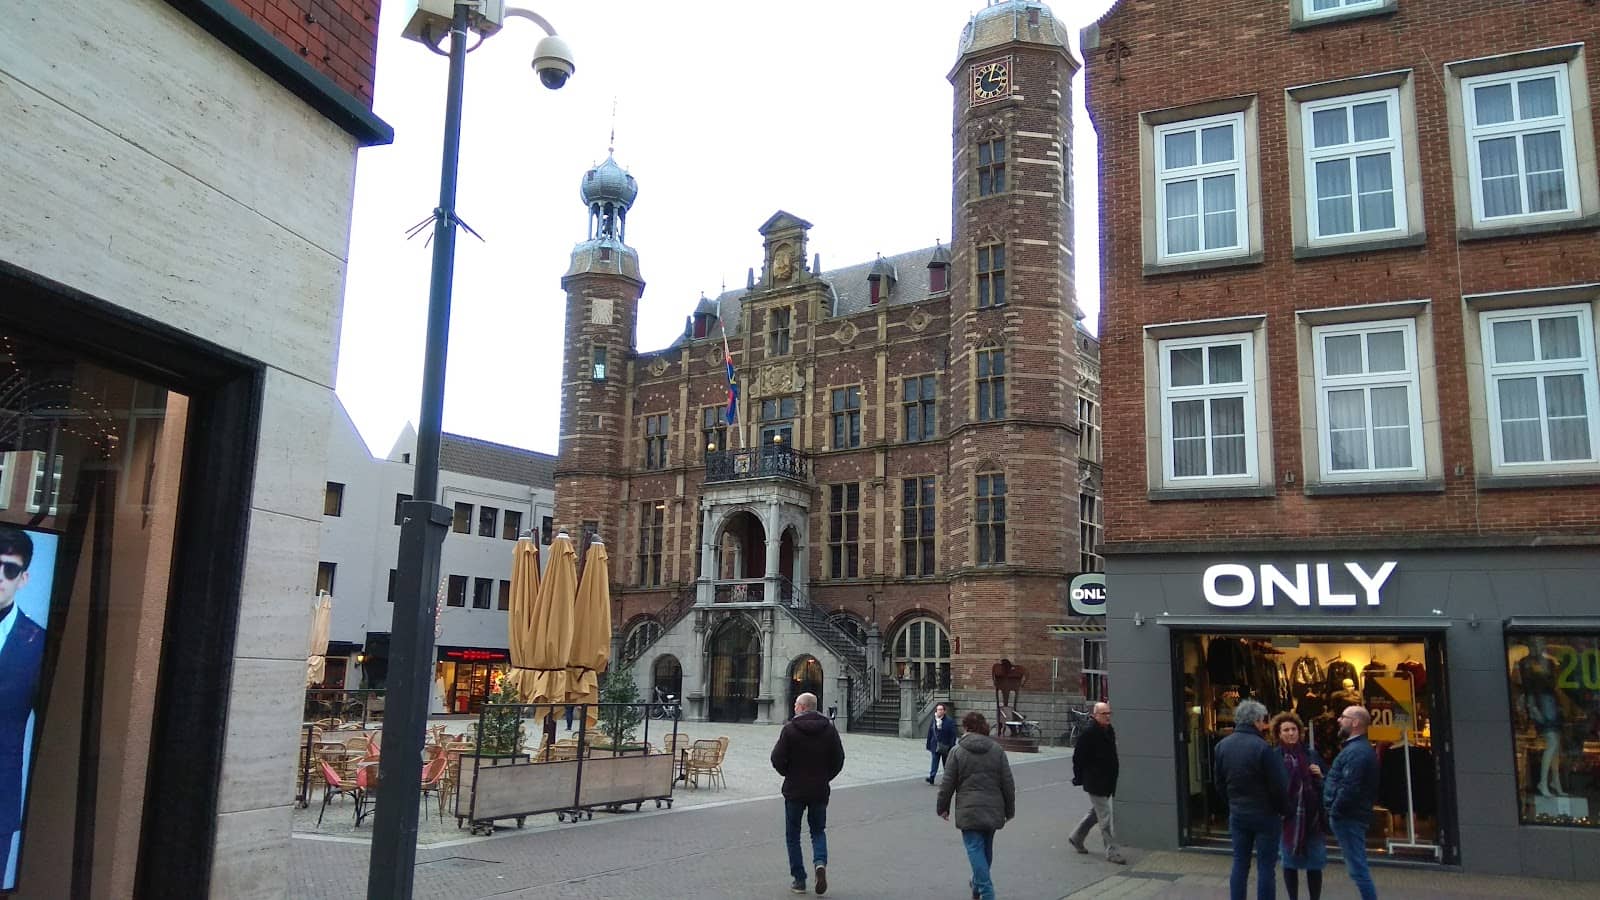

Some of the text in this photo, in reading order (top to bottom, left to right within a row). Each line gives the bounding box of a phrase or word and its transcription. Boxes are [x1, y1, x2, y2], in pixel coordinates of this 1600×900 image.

[1203, 561, 1398, 607] ONLY
[1558, 646, 1600, 690] 20
[1371, 708, 1393, 728] 20
